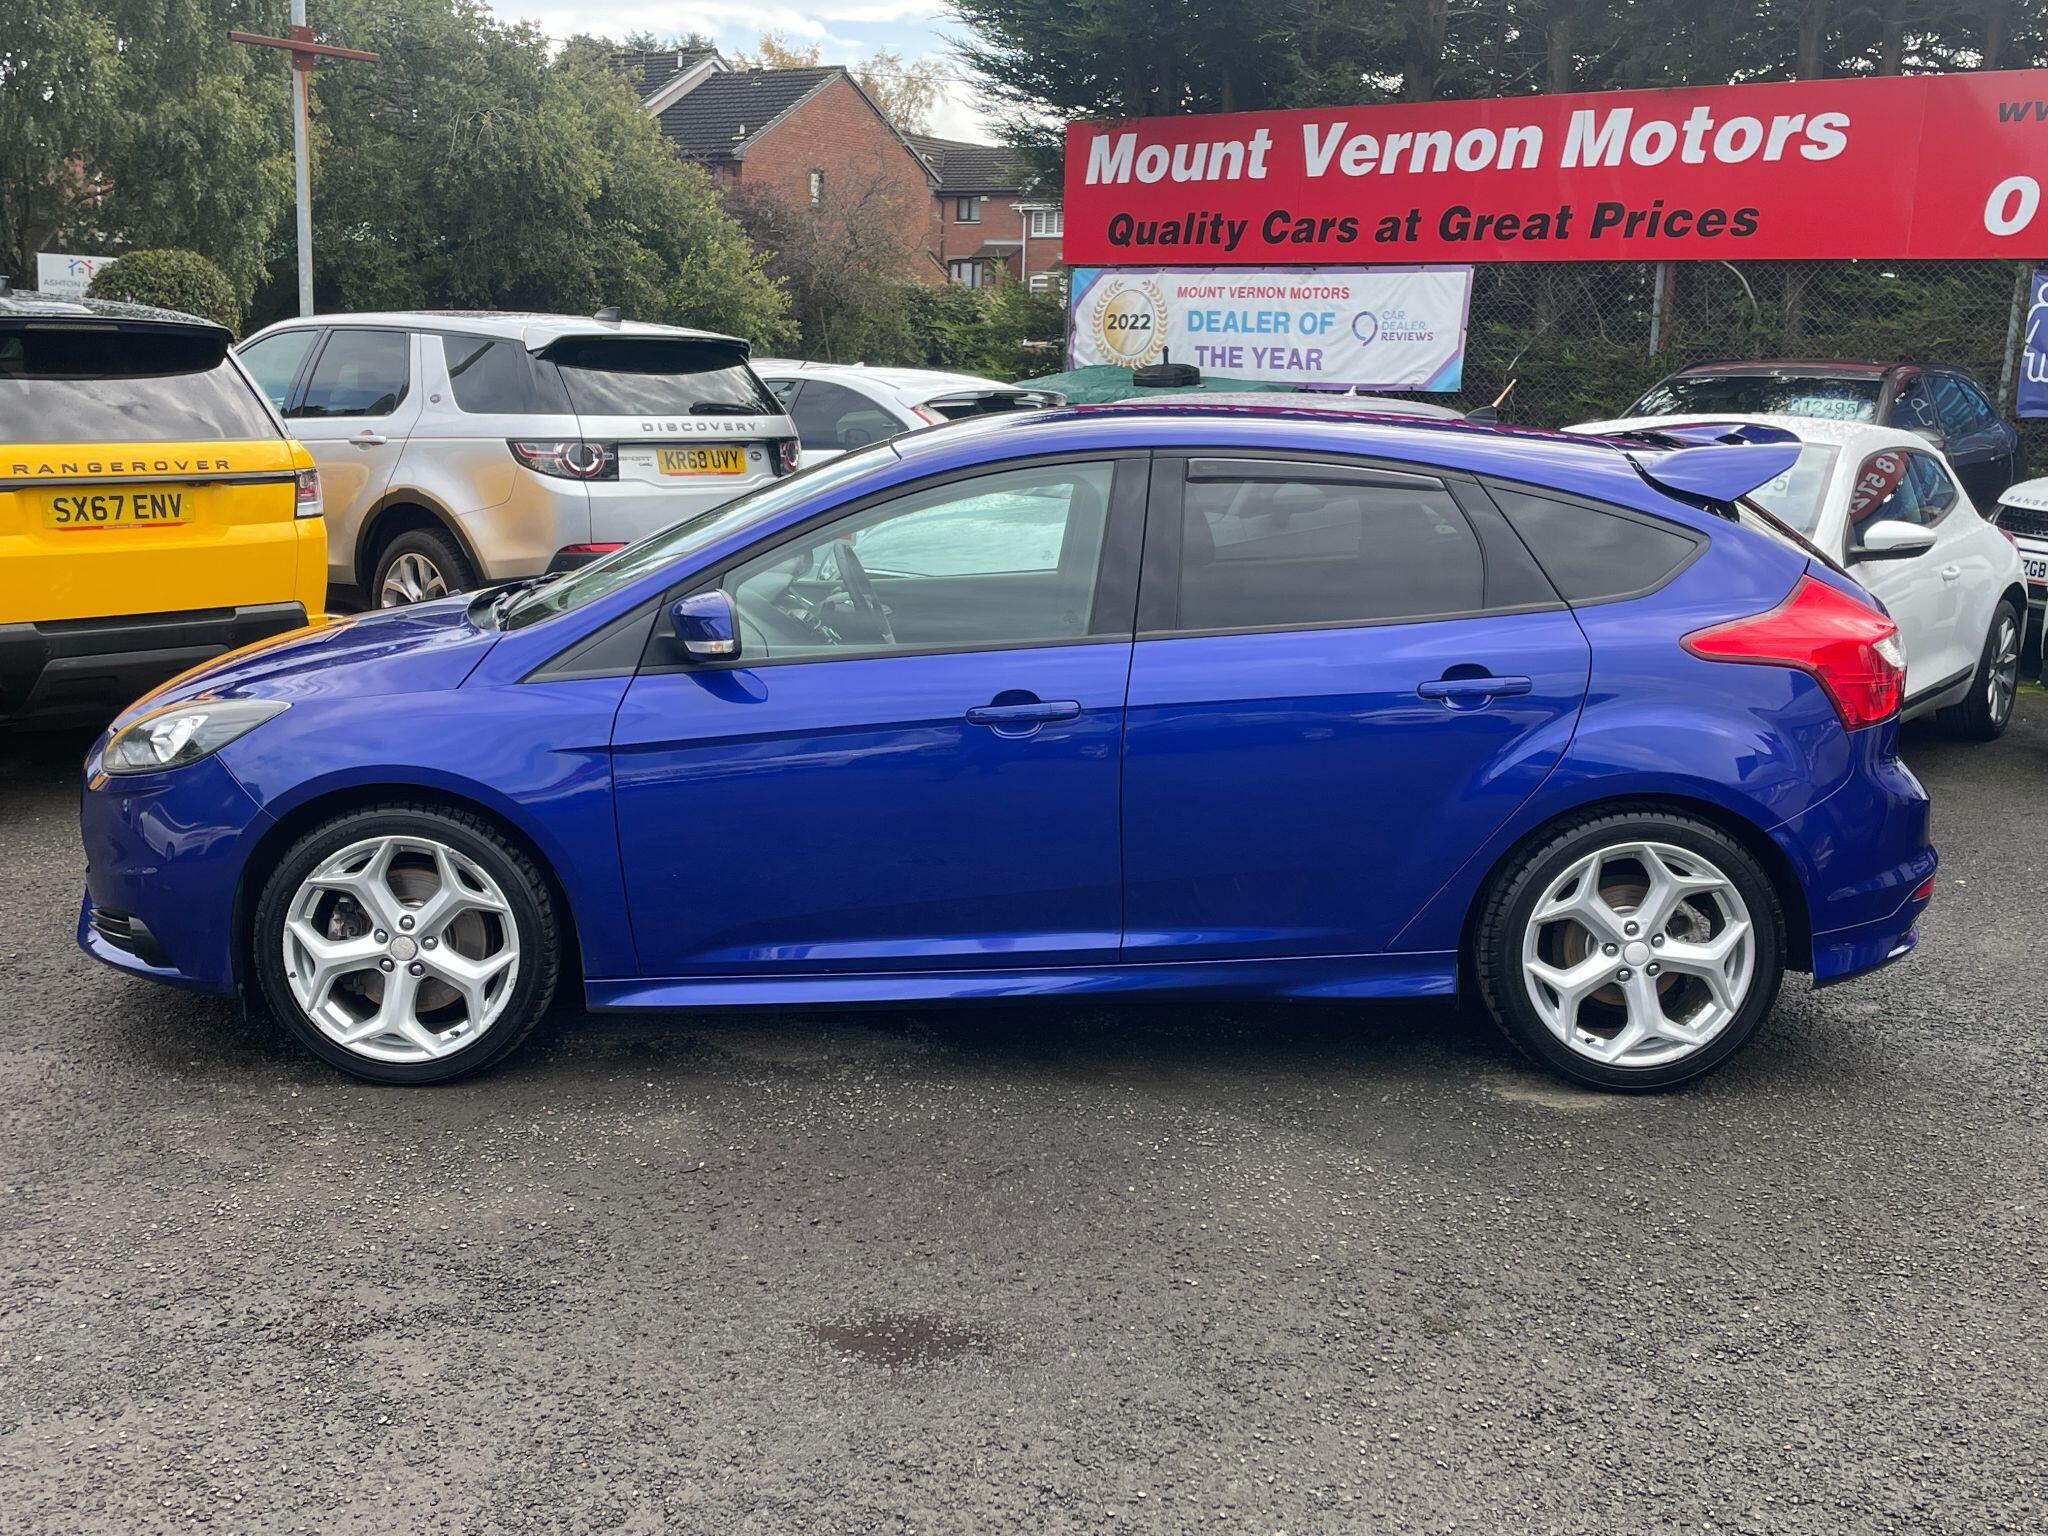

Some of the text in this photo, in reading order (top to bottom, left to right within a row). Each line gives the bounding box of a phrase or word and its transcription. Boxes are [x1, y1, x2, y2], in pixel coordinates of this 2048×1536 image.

[1085, 106, 1851, 185] Mount Vernon Motors
[1108, 200, 1760, 251] Quality Cars at Great Prices
[43, 279, 81, 288] ASHTON
[1177, 286, 1350, 299] MOUNT VERNON MOTORS
[1107, 313, 1151, 331] 2022
[1187, 310, 1335, 335] DEALER OF
[1382, 310, 1406, 320] CAR
[1382, 321, 1427, 331] DEALER
[1380, 332, 1434, 341] REVIEWS
[1195, 345, 1323, 371] THE YEAR
[642, 422, 757, 432] DISCOVERY
[664, 451, 708, 470] KR68
[710, 451, 739, 469] UVY
[53, 493, 182, 523] SX67 ENV
